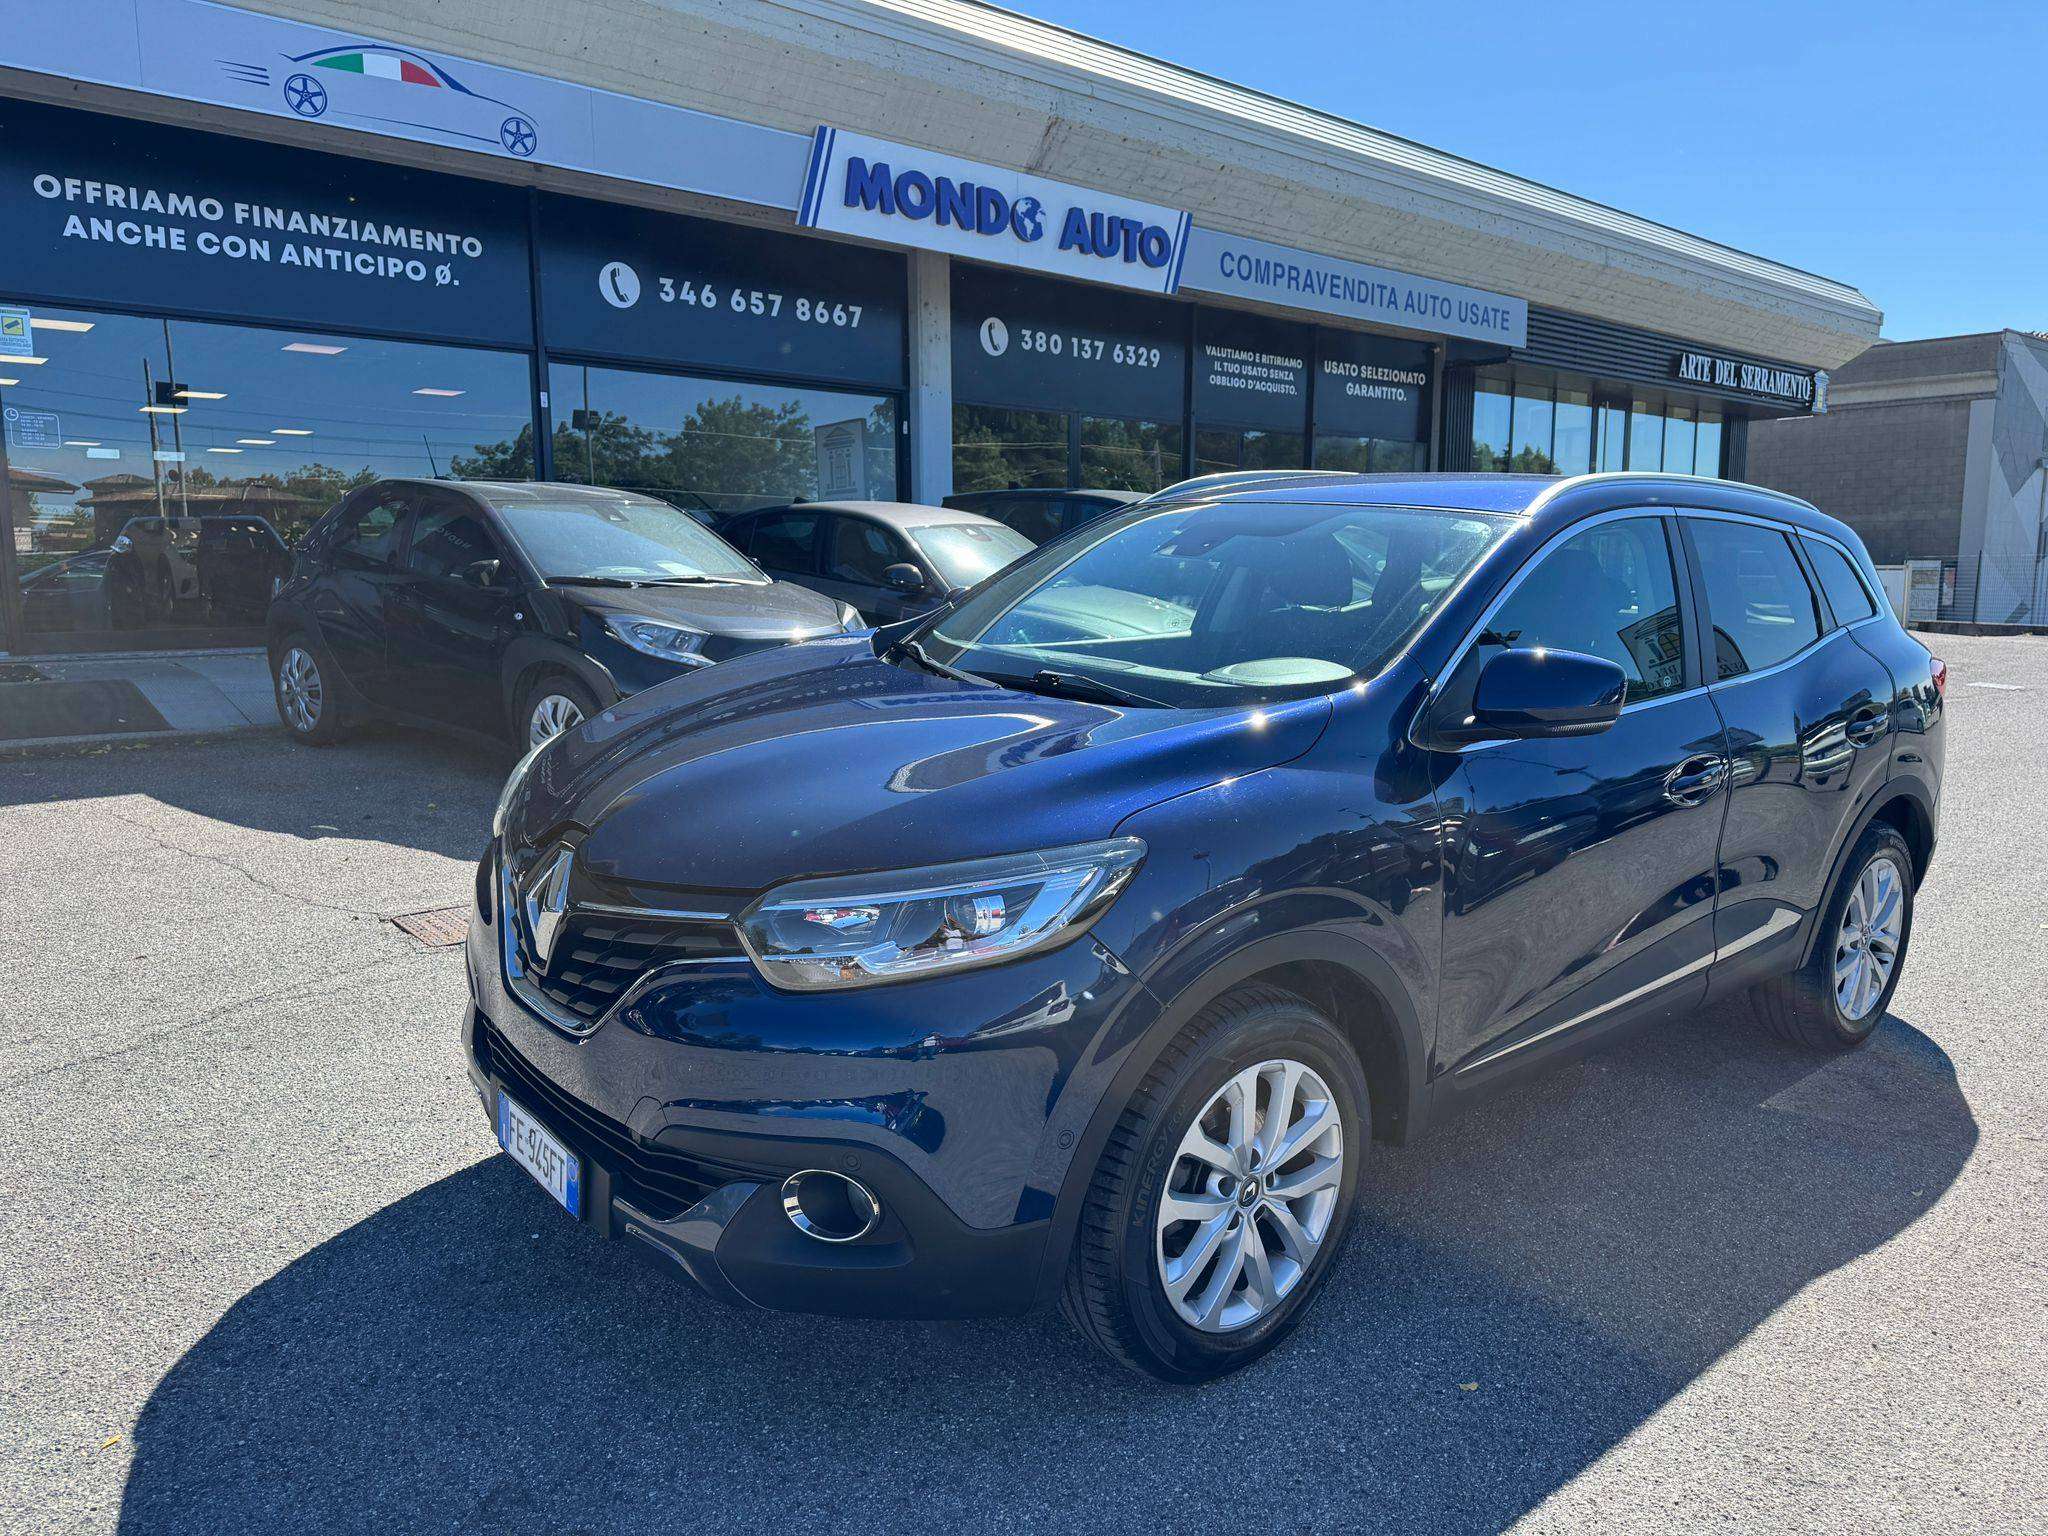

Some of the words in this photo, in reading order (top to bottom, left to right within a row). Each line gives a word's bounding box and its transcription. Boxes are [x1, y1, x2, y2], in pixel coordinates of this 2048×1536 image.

[33, 173, 224, 221] OFFRIAMO
[234, 203, 483, 258] FINANZIAMENTO
[844, 156, 1046, 242] MONDO
[1058, 207, 1172, 267] AUTO
[62, 215, 187, 252] ANCHE
[196, 231, 270, 261] CON
[280, 243, 427, 282] ANTICIPO
[659, 277, 717, 308] 346
[730, 288, 783, 317] 657
[795, 298, 863, 328] 8667
[1219, 251, 1399, 311] COMPRAVENDITA
[1404, 289, 1452, 319] AUTO
[1458, 301, 1511, 331] USATE
[1021, 328, 1062, 355] 380
[1071, 337, 1105, 361] 137
[1112, 343, 1161, 368] 6329
[1205, 345, 1254, 362] VALUTIAMO
[1255, 353, 1261, 363] E
[1261, 353, 1303, 369] RITIRIAMO
[1209, 375, 1246, 388] OBBLIGO
[1247, 380, 1298, 396] D'ACQUISTO.
[1214, 361, 1222, 372] IL
[1223, 362, 1241, 374] TUO
[1241, 365, 1269, 378] USATO
[1269, 369, 1295, 382] SENZA
[1324, 360, 1359, 377] USATO
[1360, 364, 1426, 385] SELEZIONATO
[1345, 382, 1407, 402] GARANTITO.
[1678, 352, 1712, 383] ARTE
[1714, 359, 1738, 387] DEL
[1740, 363, 1811, 401] SERRAMENTO
